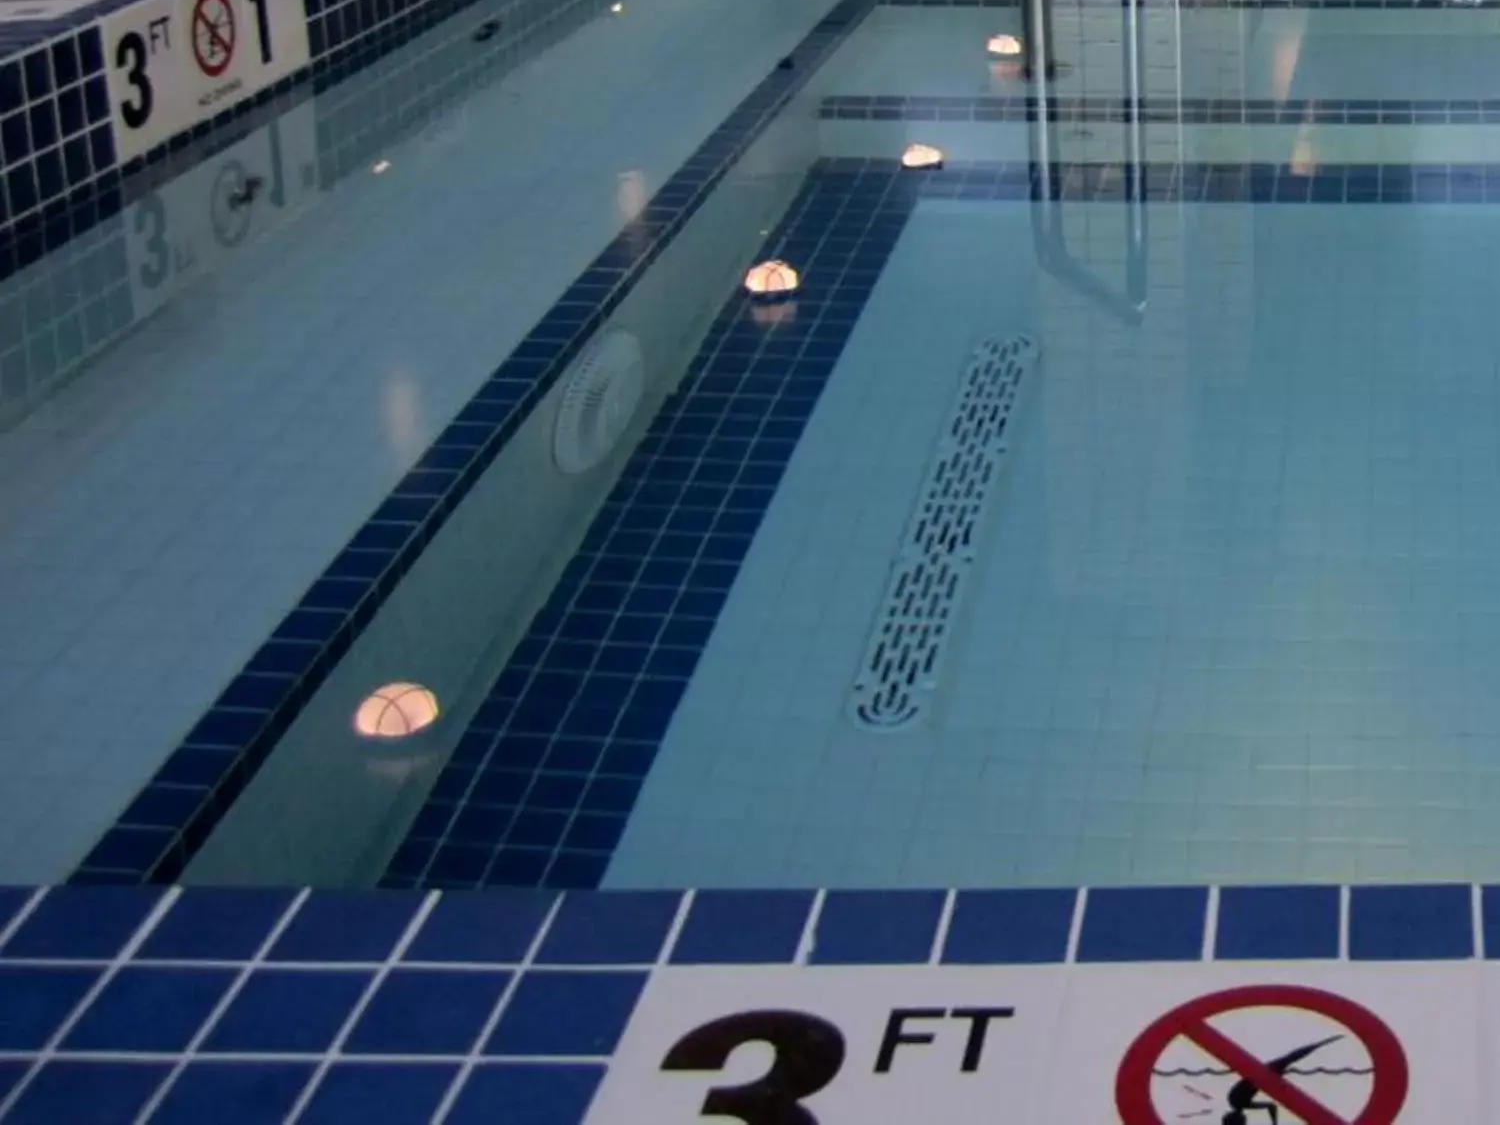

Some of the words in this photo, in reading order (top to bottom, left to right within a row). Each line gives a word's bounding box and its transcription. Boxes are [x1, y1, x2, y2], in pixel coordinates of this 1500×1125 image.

[116, 32, 153, 129] 3
[148, 15, 171, 55] FT
[660, 1009, 846, 1125] 3
[873, 1007, 1014, 1073] FT
